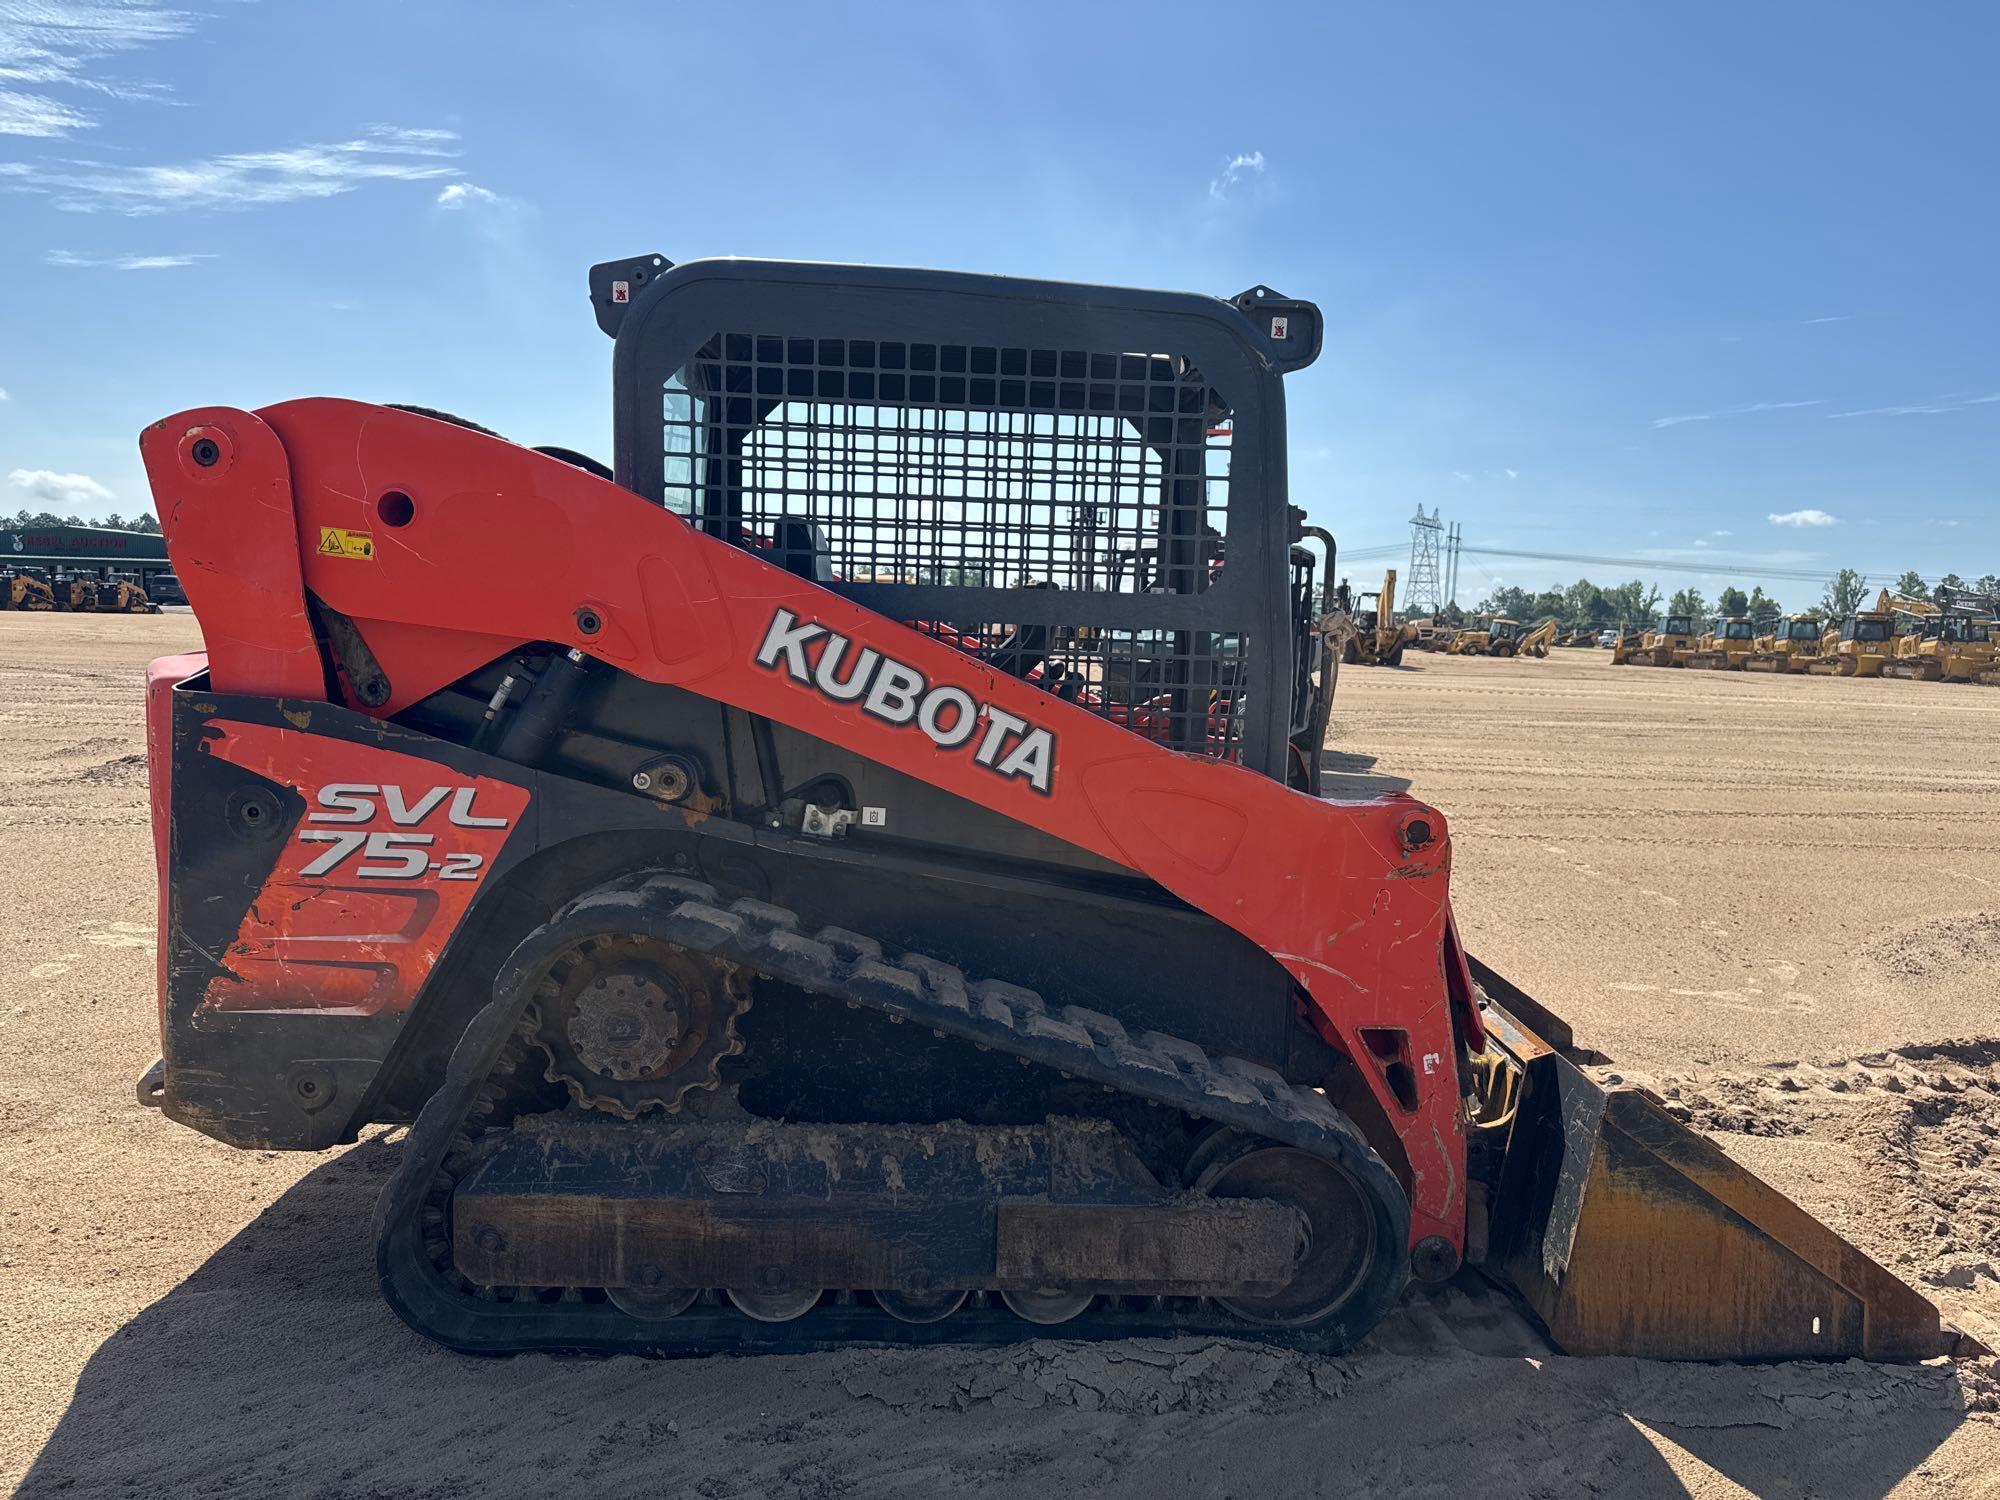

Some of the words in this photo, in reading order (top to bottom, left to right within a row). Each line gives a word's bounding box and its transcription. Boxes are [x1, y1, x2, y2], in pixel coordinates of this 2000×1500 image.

[1865, 645, 1877, 653] CAT
[756, 607, 1054, 793] KUBOTA
[307, 783, 508, 829] SVL
[298, 829, 484, 881] 75-2
